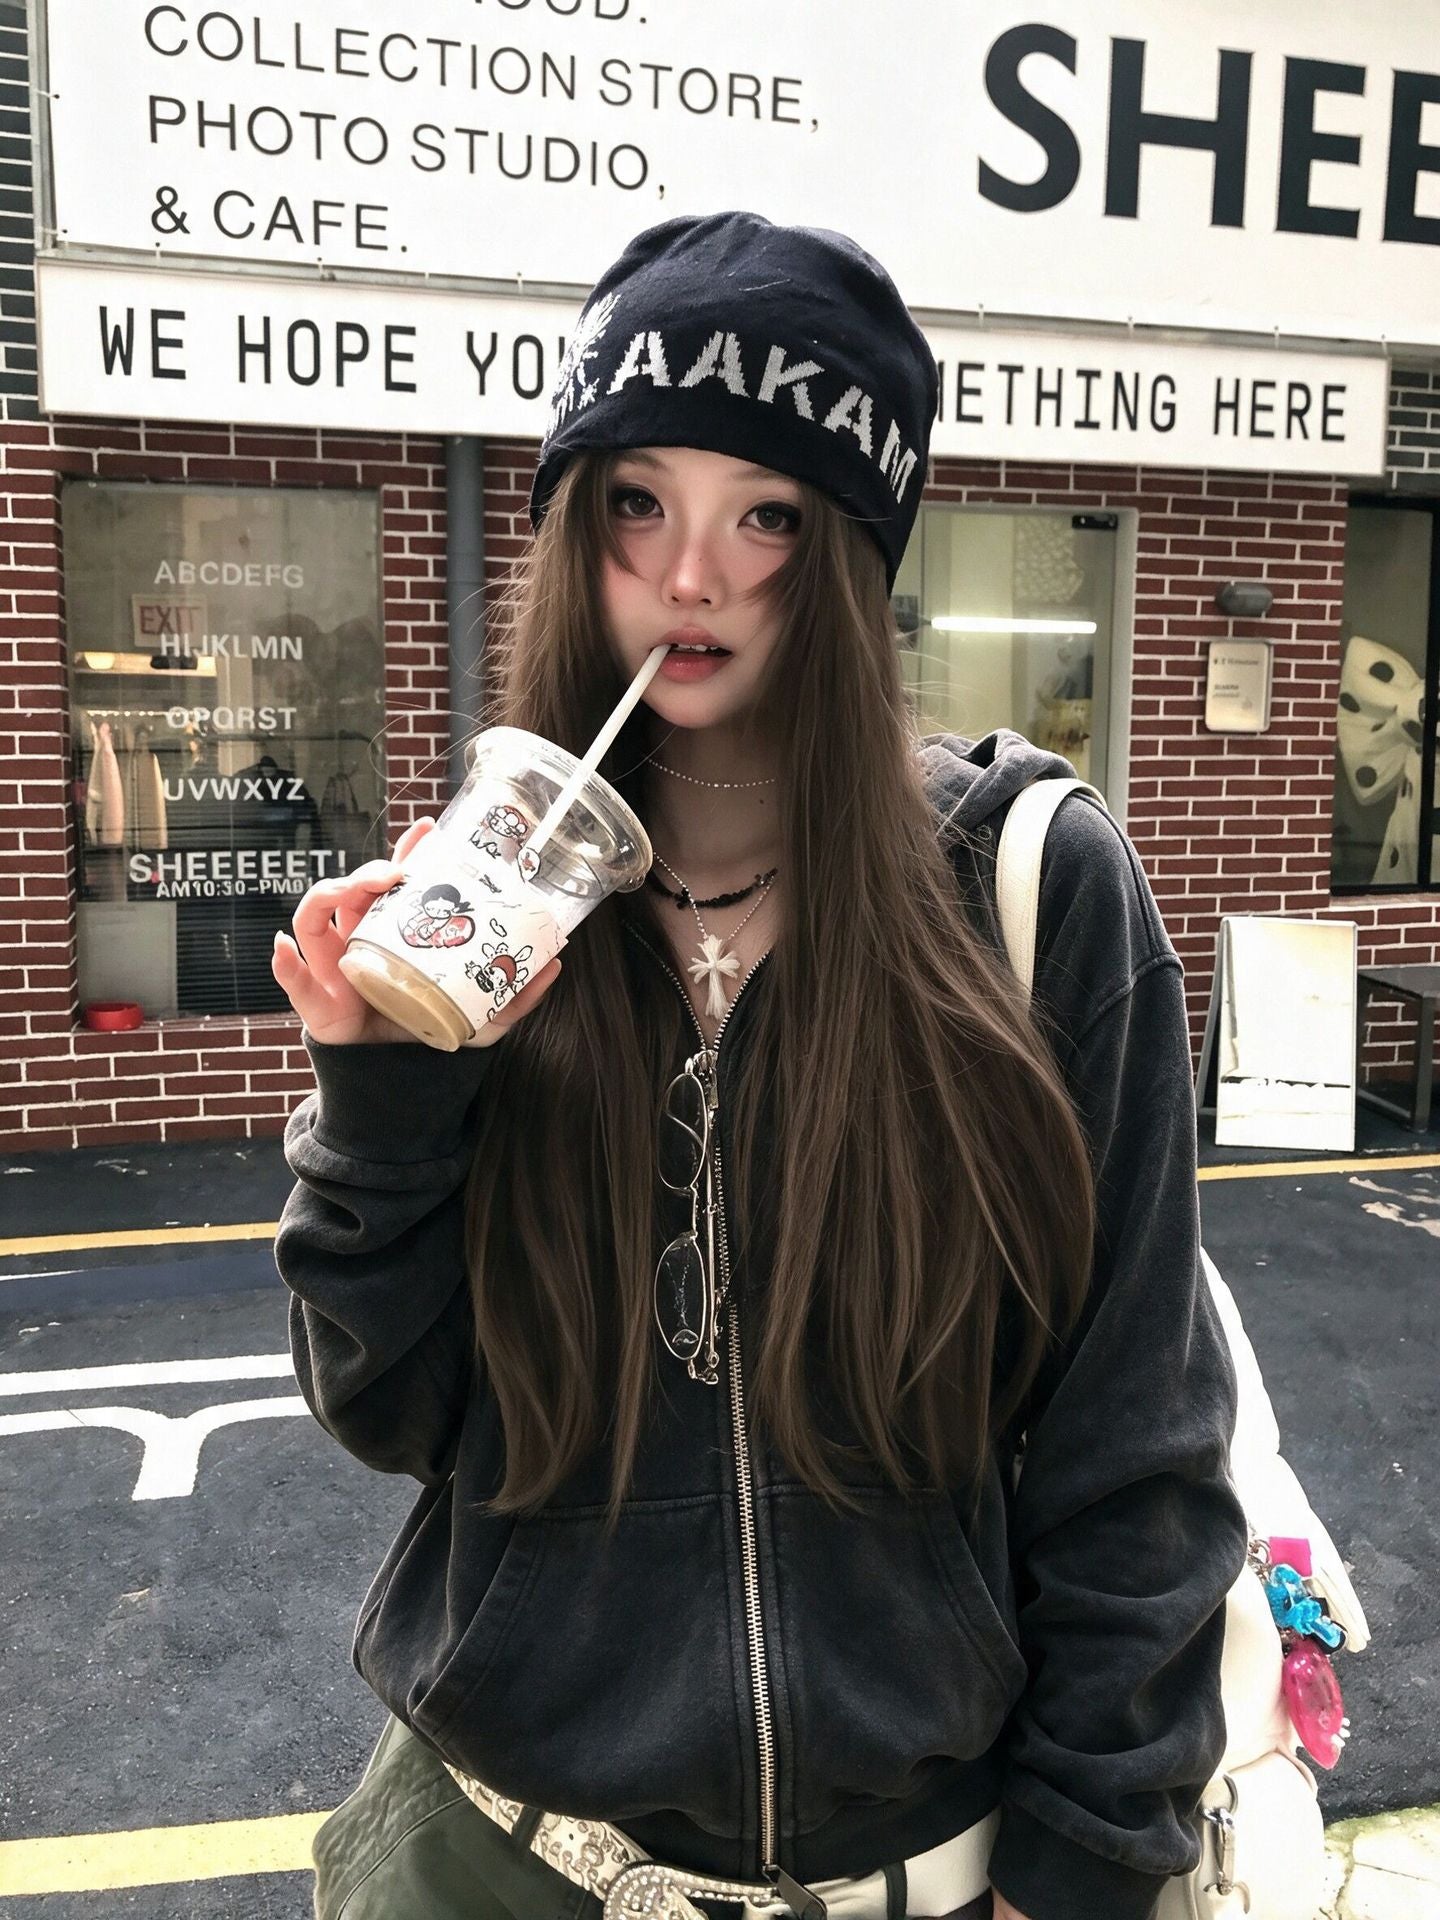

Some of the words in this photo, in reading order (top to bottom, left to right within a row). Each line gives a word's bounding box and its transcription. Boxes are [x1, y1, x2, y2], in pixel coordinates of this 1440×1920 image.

[144, 5, 575, 100] COLLECTION
[599, 59, 820, 133] STORE,
[149, 95, 388, 165] PHOTO
[410, 123, 665, 200] STUDIO,
[977, 23, 1440, 247] SHEE
[151, 185, 191, 235] &
[212, 190, 408, 252] CAFE.
[99, 305, 188, 380] WE
[238, 315, 418, 393] HOPE
[466, 331, 566, 400] YO
[937, 361, 1177, 433] ETHING
[1213, 377, 1347, 442] HERE
[153, 560, 304, 589] ABCDEFG
[139, 605, 200, 636] EXIT
[160, 633, 304, 661] HIJKLMN
[167, 706, 297, 731] OPQRST
[163, 777, 305, 801] UVWXYZ
[129, 850, 347, 884] SHEEEEET!
